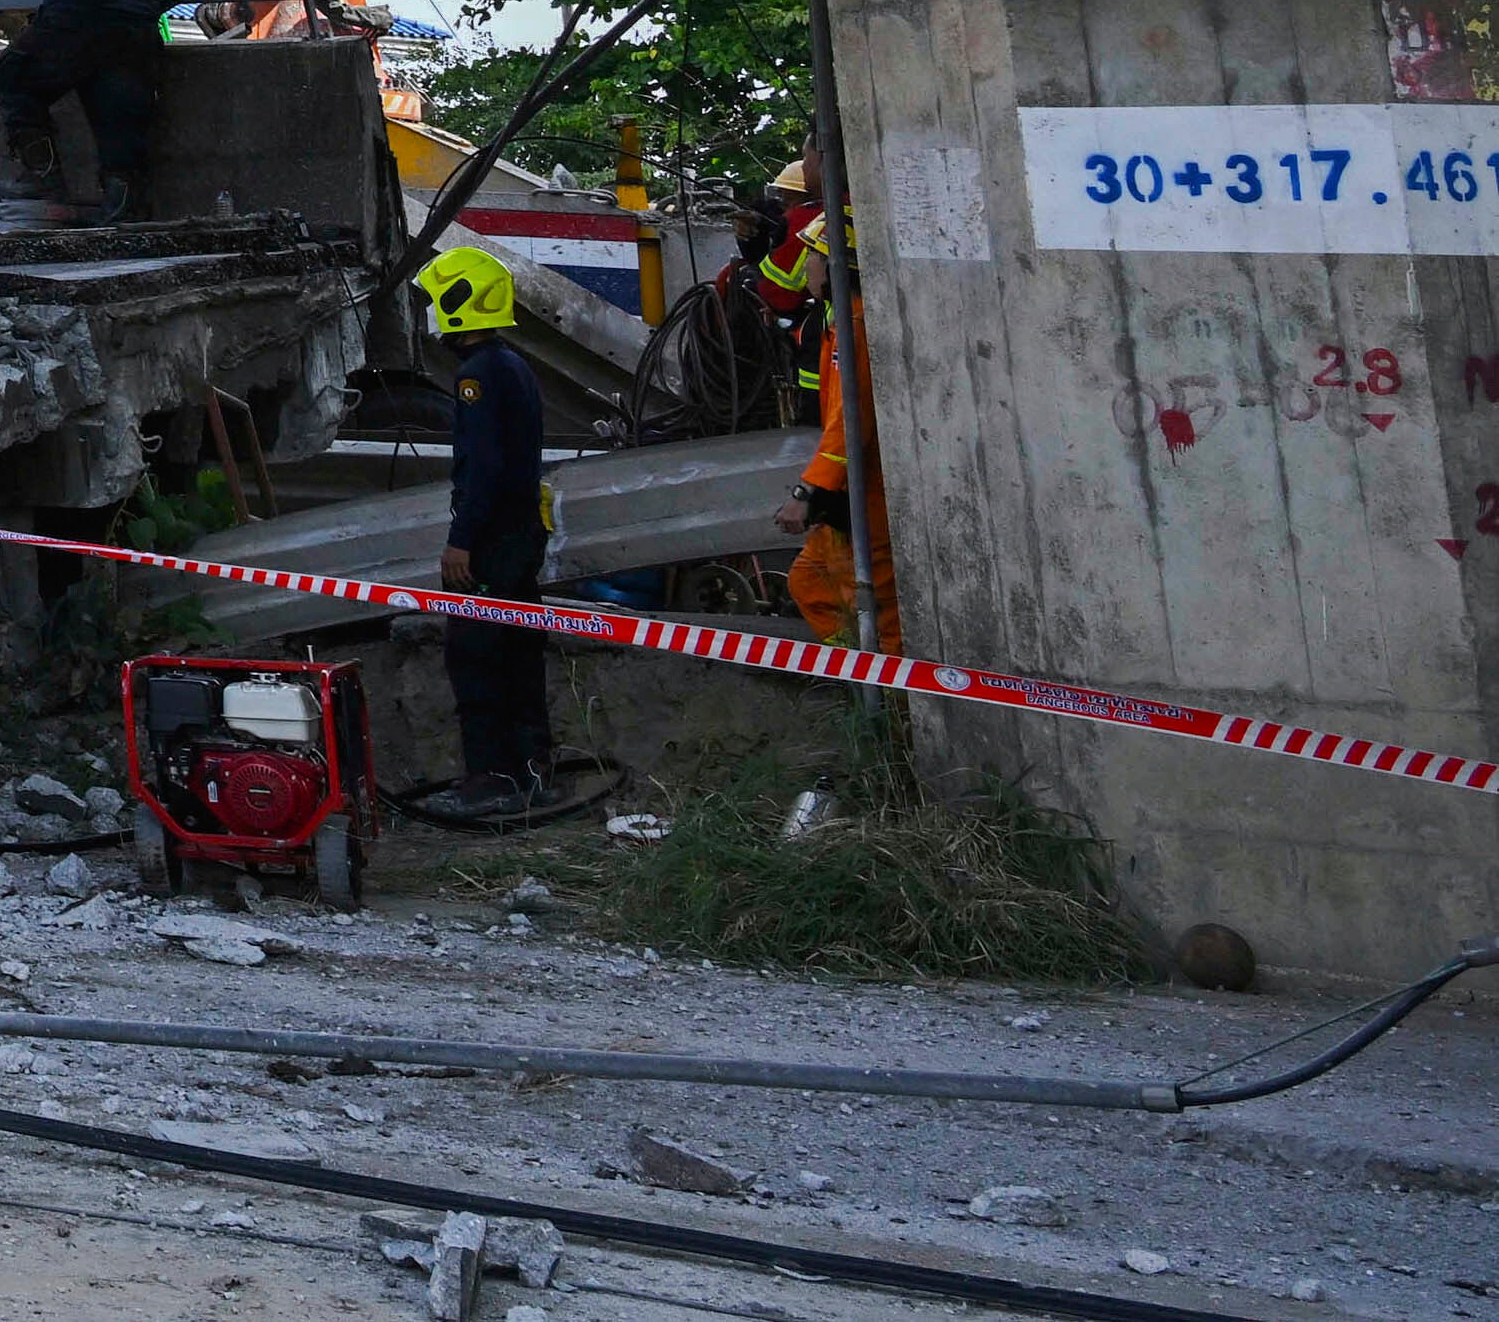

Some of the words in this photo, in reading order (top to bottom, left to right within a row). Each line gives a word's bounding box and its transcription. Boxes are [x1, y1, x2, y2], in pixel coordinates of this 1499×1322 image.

[1085, 148, 1499, 205] 30+317.461
[1313, 344, 1403, 396] 2.8
[1025, 694, 1110, 717] DANGEROUS
[1113, 709, 1151, 725] AREA
